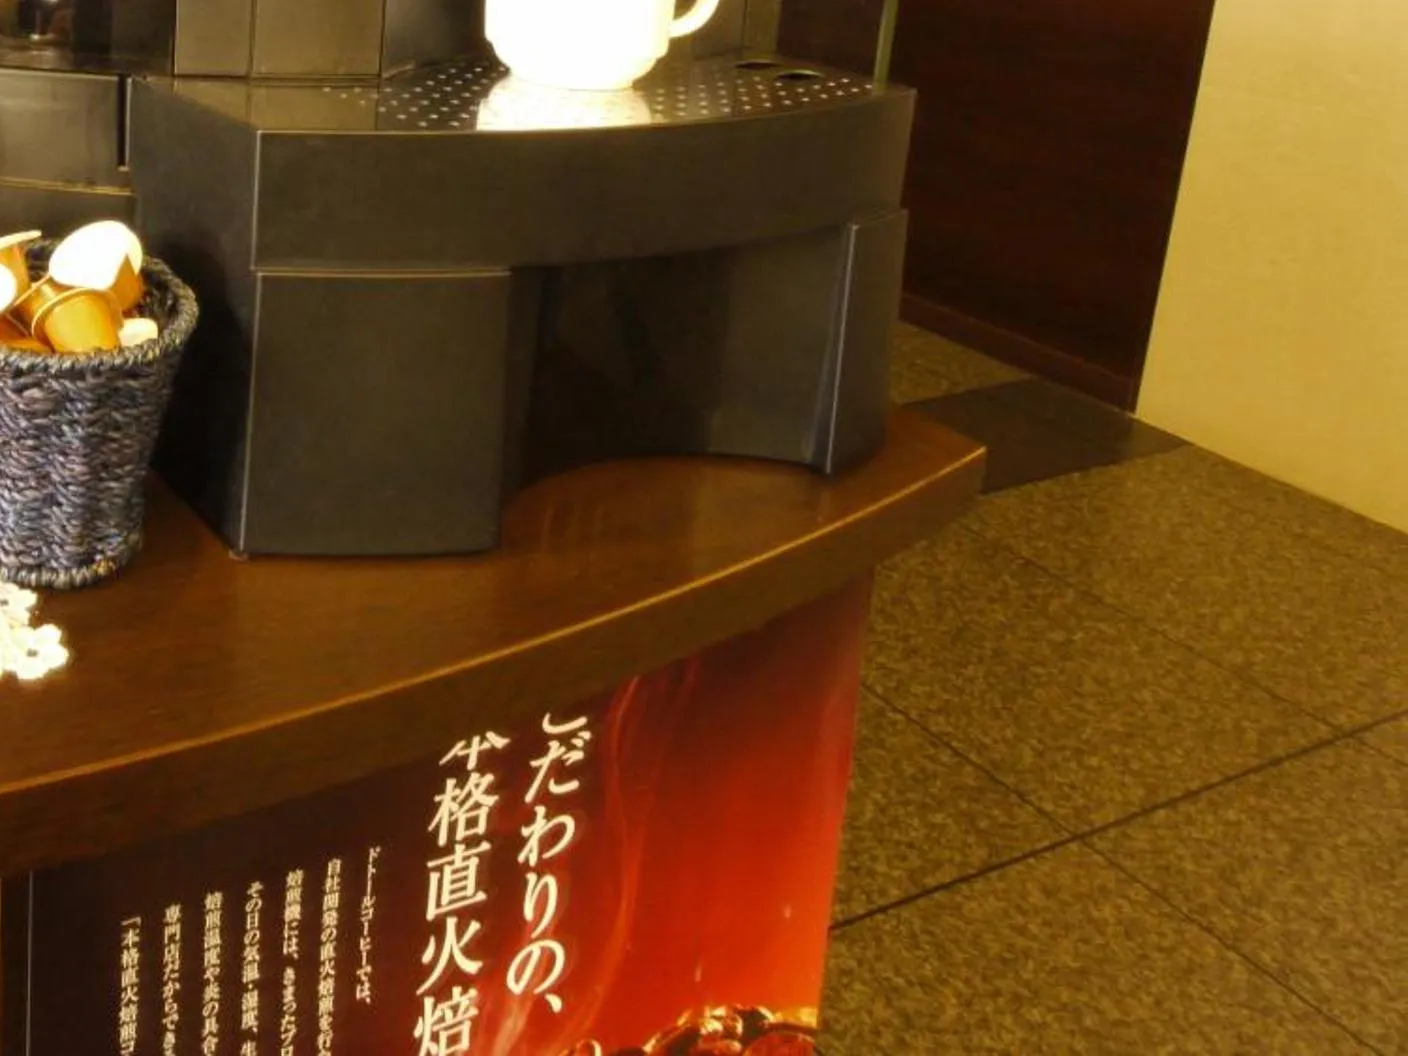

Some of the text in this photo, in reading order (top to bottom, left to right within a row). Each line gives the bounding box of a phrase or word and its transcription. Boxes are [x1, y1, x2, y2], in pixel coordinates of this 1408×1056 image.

[119, 916, 141, 1056] 「本格直火焙煎コ
